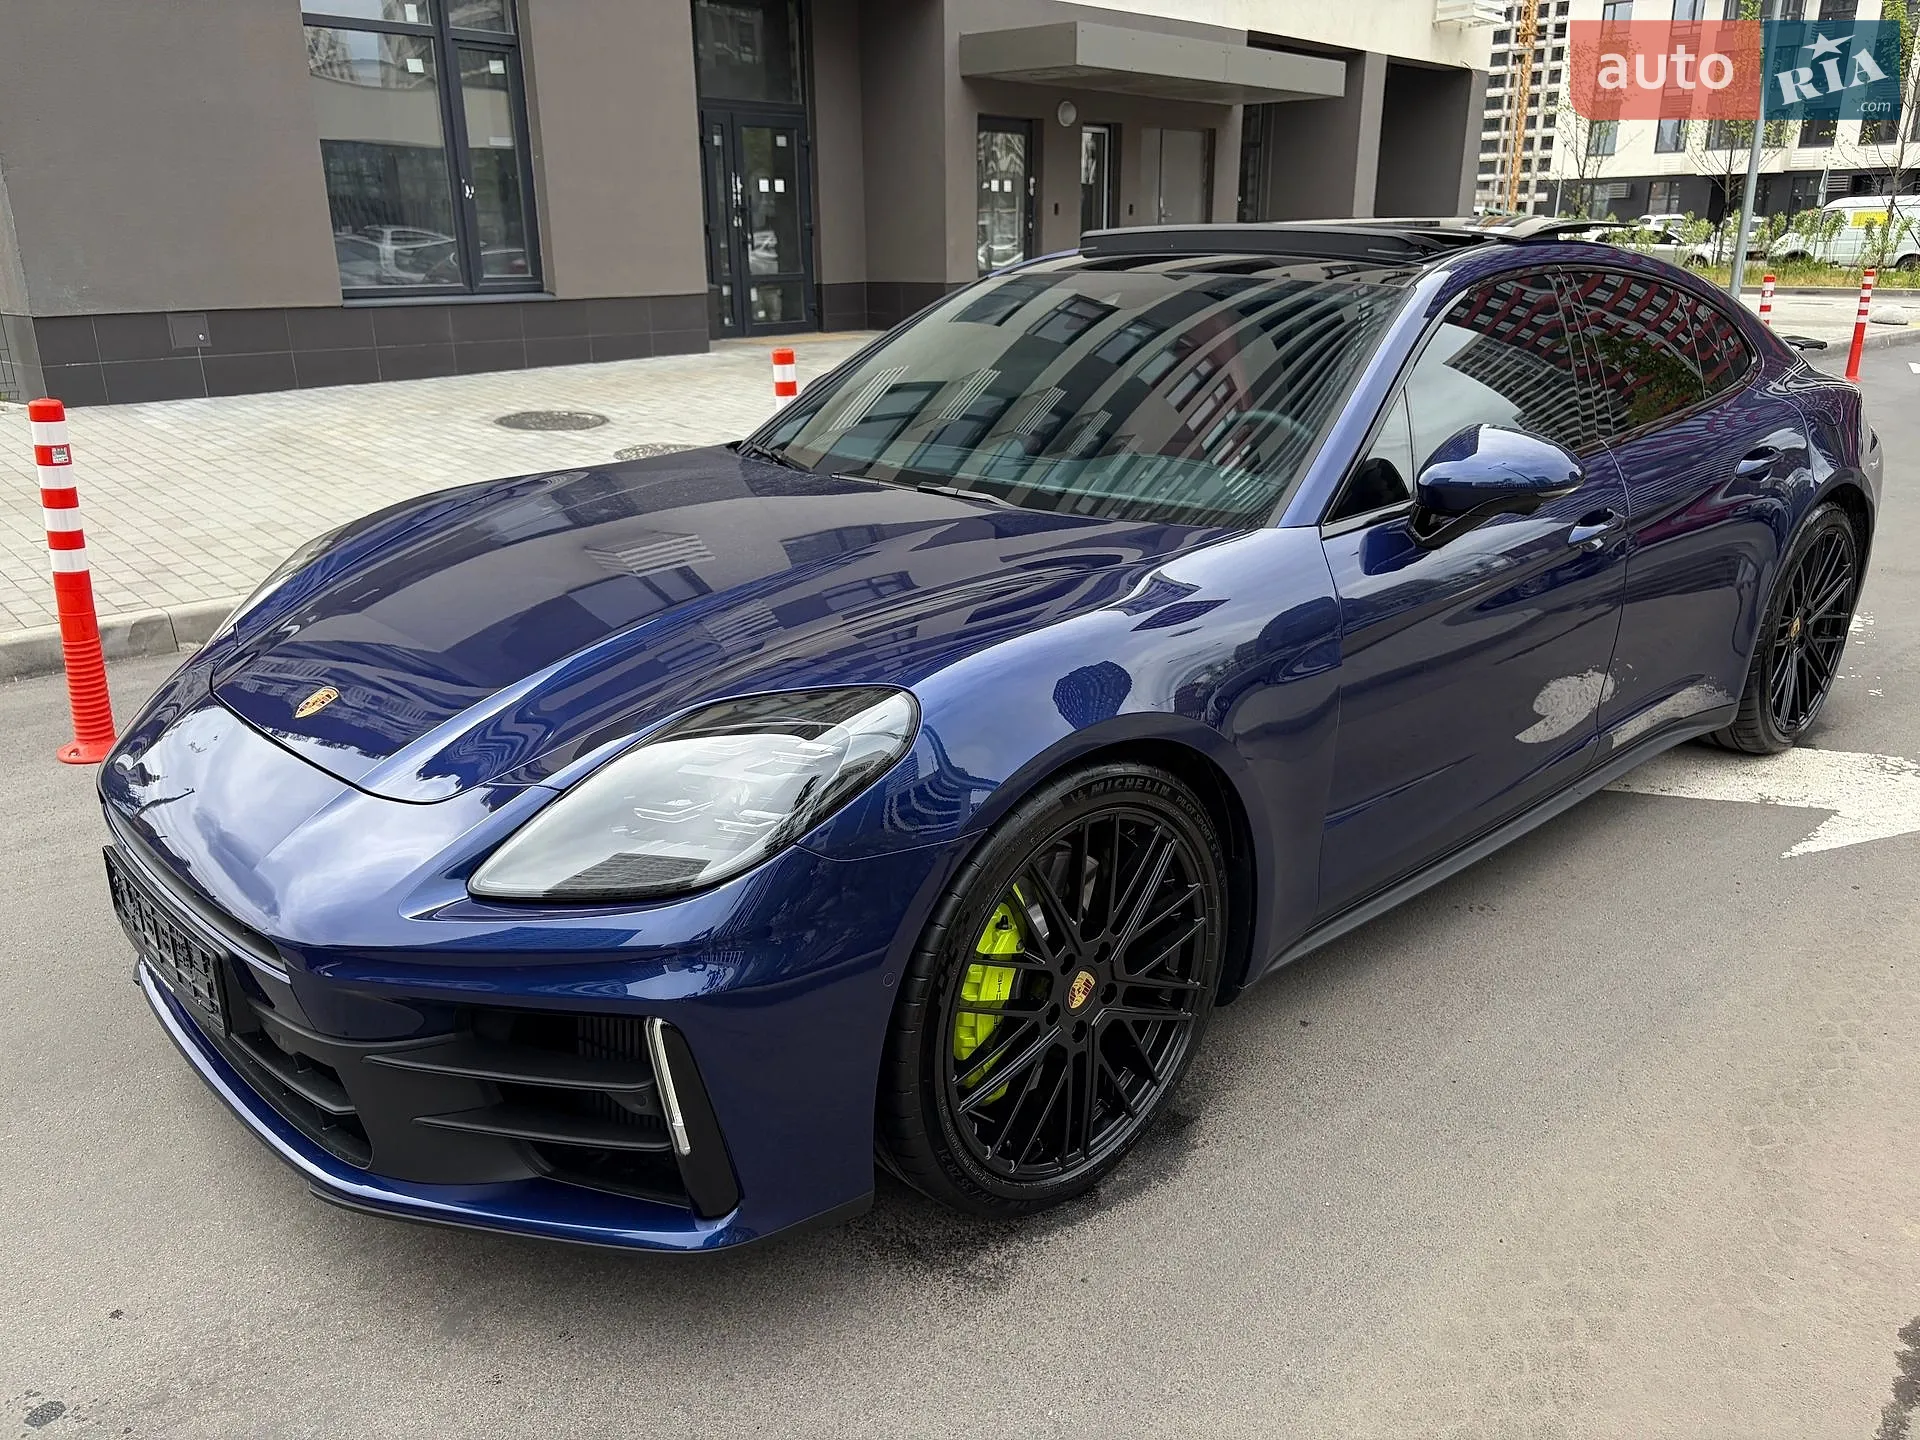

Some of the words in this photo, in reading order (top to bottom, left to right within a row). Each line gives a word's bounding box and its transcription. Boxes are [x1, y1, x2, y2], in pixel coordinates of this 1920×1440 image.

[1091, 778, 1171, 797] MICHELIN
[1175, 795, 1196, 815] PILOT
[1194, 813, 1214, 841] SPORT
